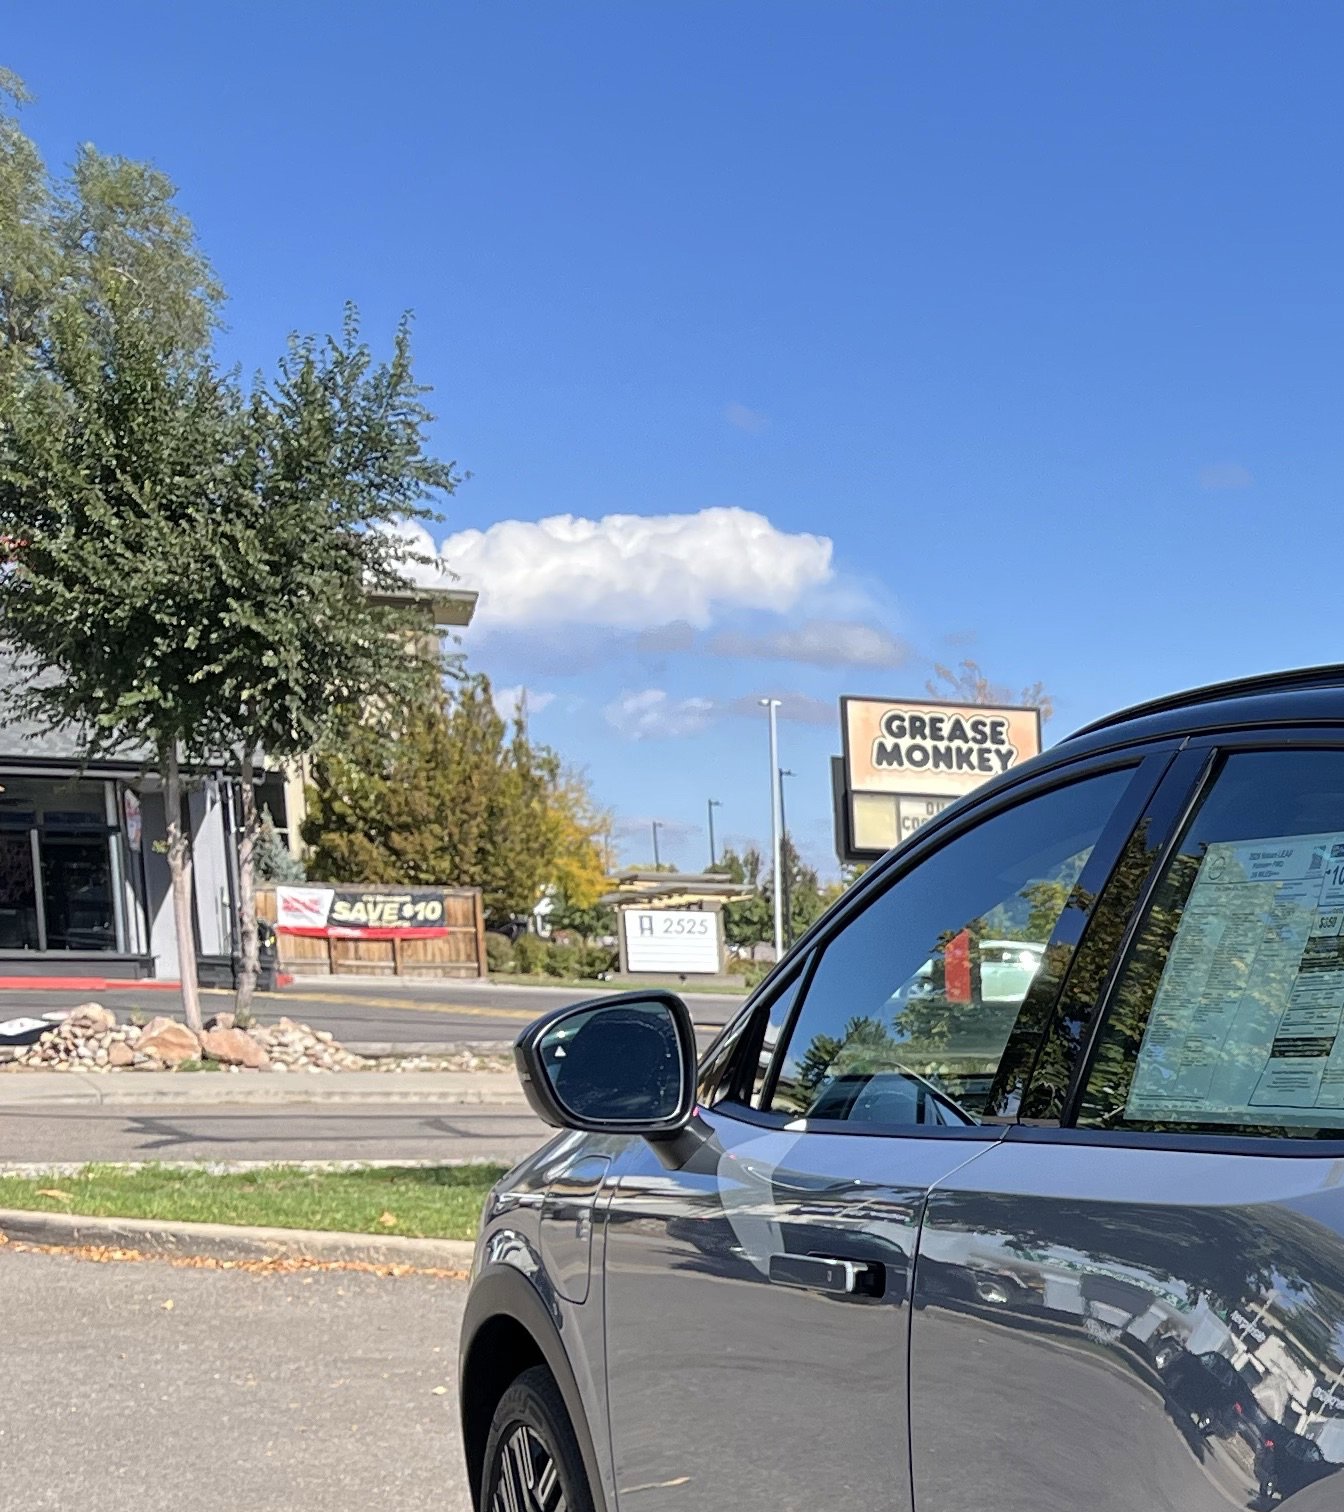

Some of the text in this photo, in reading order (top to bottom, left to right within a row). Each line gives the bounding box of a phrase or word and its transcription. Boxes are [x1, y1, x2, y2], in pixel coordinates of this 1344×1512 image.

[884, 713, 1007, 746] GREASE
[874, 741, 1015, 772] MONKEY
[332, 900, 401, 923] SAVE
[663, 918, 709, 936] 2525
